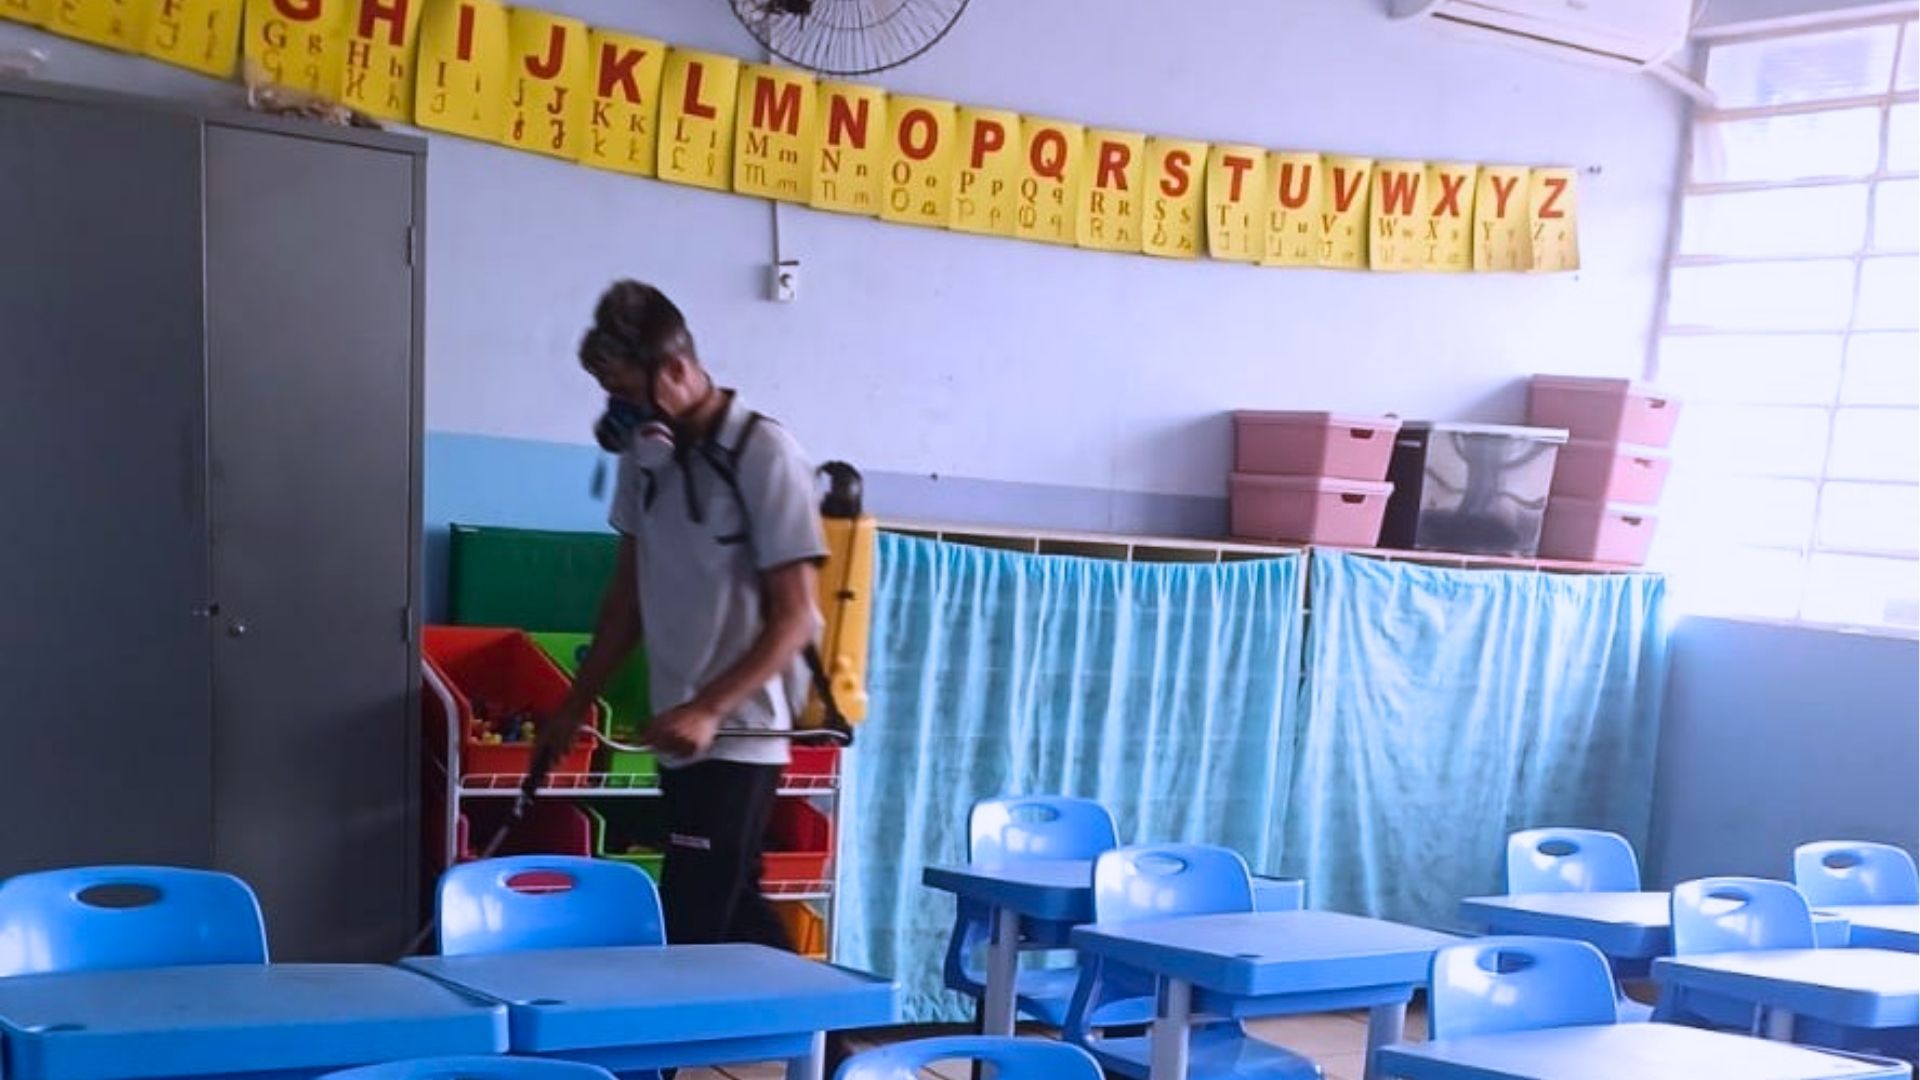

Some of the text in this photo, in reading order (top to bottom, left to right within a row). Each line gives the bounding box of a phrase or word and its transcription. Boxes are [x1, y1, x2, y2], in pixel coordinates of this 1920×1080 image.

[263, 21, 286, 48] G
[358, 0, 408, 46] H
[457, 5, 474, 61] I
[348, 40, 403, 77] H h
[525, 24, 566, 79] J
[598, 43, 646, 103] K
[683, 62, 716, 119] L
[592, 101, 610, 127] K
[753, 76, 802, 136] M
[829, 94, 869, 149] N
[674, 118, 689, 142] L
[746, 131, 797, 164] M m
[898, 108, 938, 160] O
[970, 119, 1005, 168] P
[821, 148, 867, 177] N n
[892, 161, 910, 185] O
[1030, 129, 1067, 183] Q
[1097, 141, 1130, 191] R
[1160, 151, 1191, 197] S
[960, 170, 1004, 196] P p
[1021, 178, 1038, 203] Q
[1223, 156, 1253, 202] T
[1279, 163, 1312, 208] U
[1334, 168, 1363, 212] V
[1381, 170, 1420, 216] W
[1432, 174, 1466, 217] X
[1491, 176, 1519, 218] Y
[1538, 178, 1568, 218] Z
[1090, 191, 1104, 214] R
[1153, 200, 1166, 221] S
[1217, 204, 1231, 226] T
[1270, 211, 1286, 232] U
[1322, 214, 1337, 234] V
[1379, 218, 1397, 238] W
[1426, 220, 1440, 239] X
[1484, 222, 1495, 240] Y
